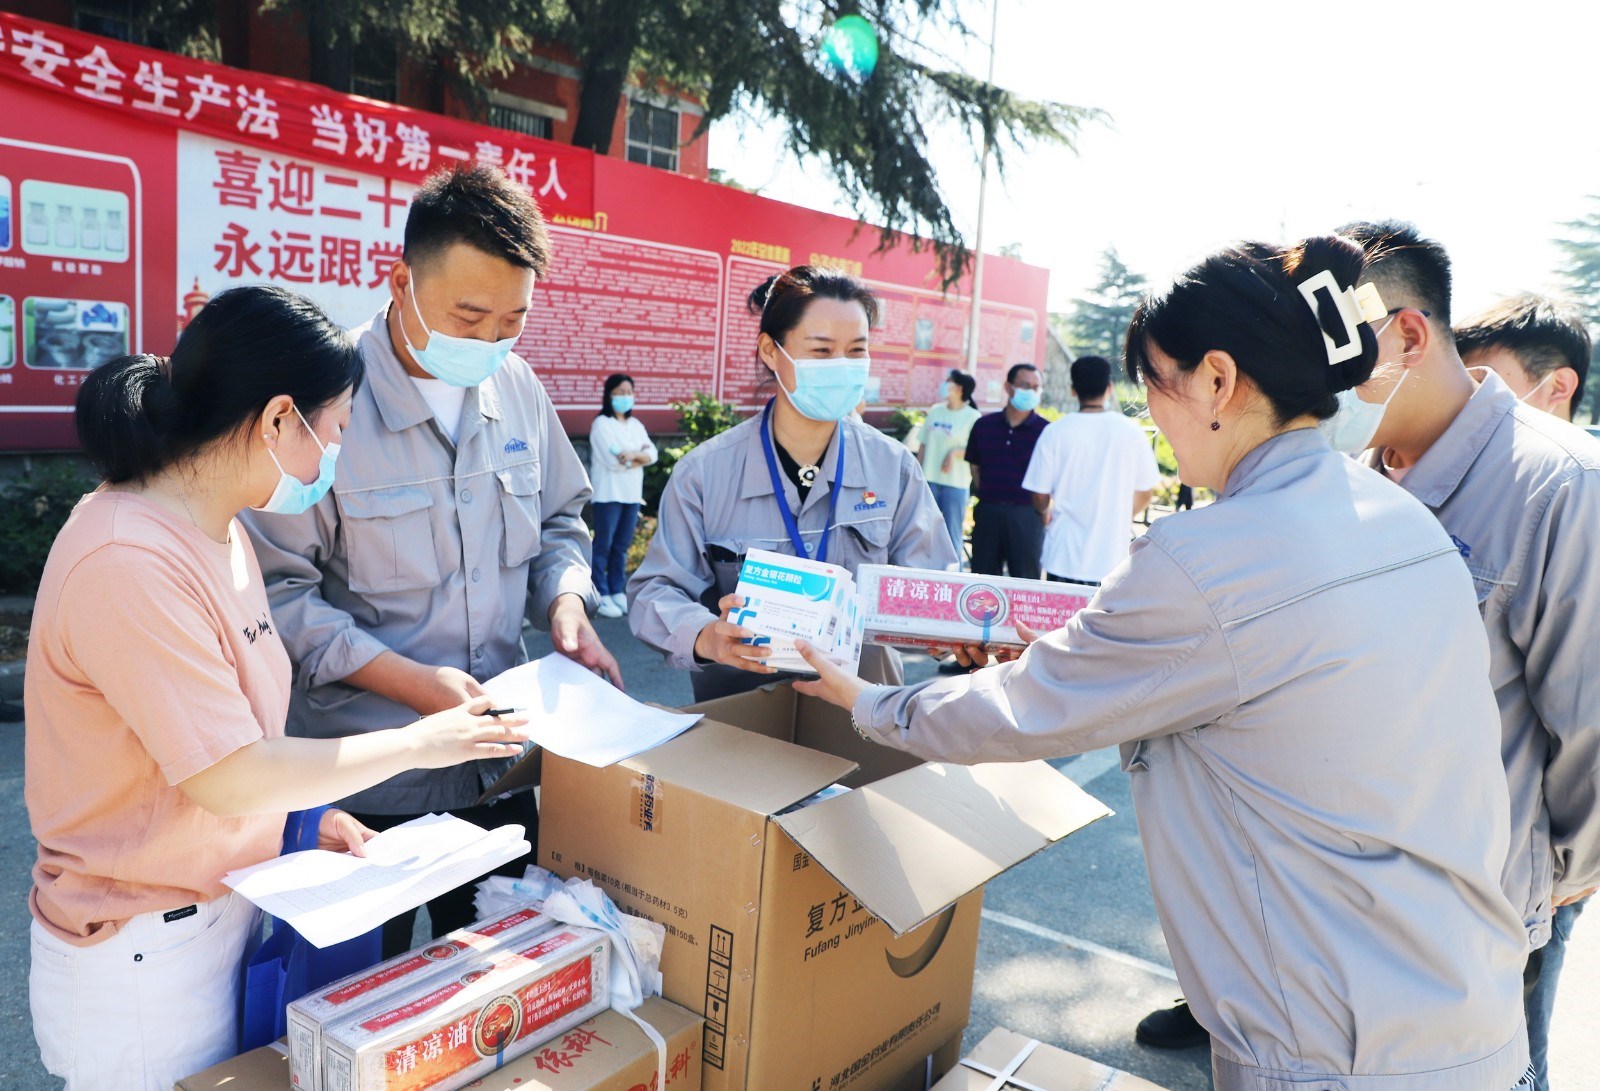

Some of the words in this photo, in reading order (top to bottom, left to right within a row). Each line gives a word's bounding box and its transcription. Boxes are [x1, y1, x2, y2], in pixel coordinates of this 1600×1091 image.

[0, 26, 280, 140] 安全生产法
[214, 222, 404, 289] 永远跟党
[887, 578, 953, 603] 清凉油
[804, 934, 840, 962] Fufang
[396, 1022, 468, 1075] 清凉油
